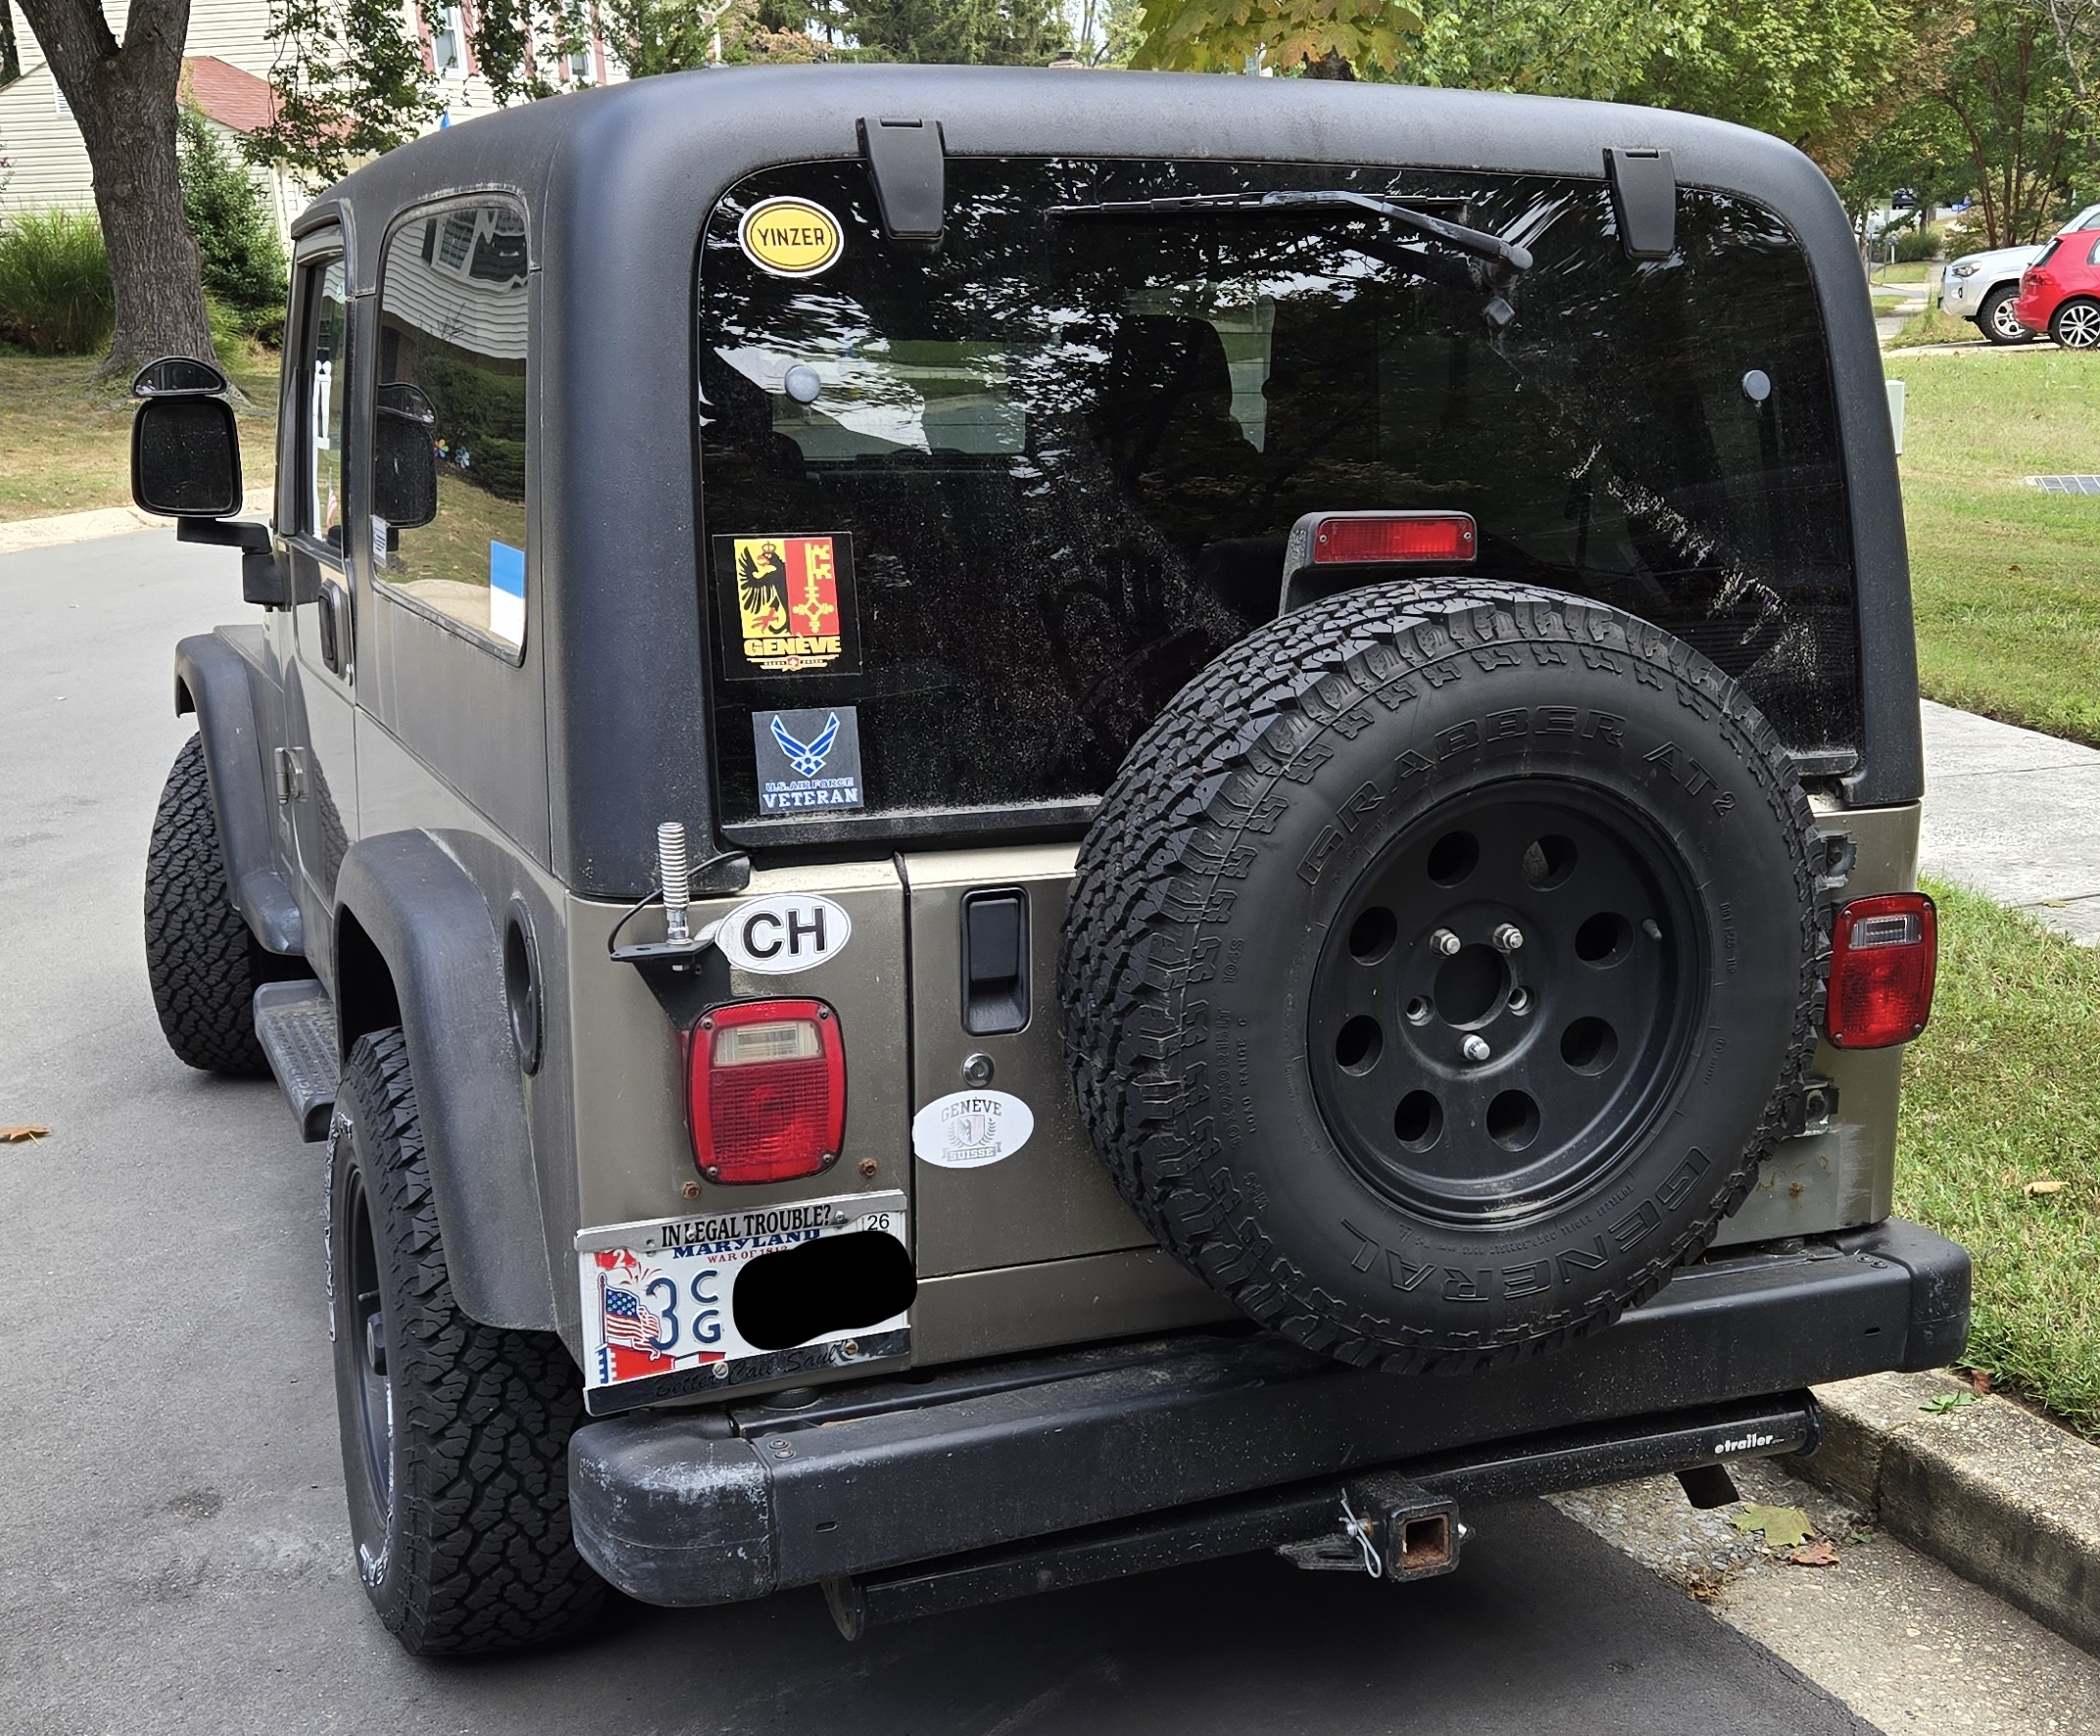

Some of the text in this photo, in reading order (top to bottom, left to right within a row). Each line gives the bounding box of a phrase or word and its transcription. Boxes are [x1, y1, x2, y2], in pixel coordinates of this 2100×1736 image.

[758, 227, 825, 246] YINZER
[743, 633, 842, 657] GENÈVE
[762, 787, 859, 809] VETERAN
[1295, 705, 1629, 886] GRABBER
[742, 906, 827, 960] CH
[1222, 937, 1244, 983] 104S
[941, 1097, 1003, 1123] GENÈVE
[949, 1148, 995, 1161] SUISSE
[661, 1204, 831, 1248] IN LEGAL TROUBLE?
[867, 1213, 890, 1232] 26
[1341, 1146, 1712, 1301] GENERAL
[672, 1229, 821, 1260] MARYLAND
[707, 1252, 738, 1264] WAR
[741, 1249, 757, 1260] OF
[654, 1345, 838, 1398] Better Call Saul
[1714, 1432, 1774, 1454] etrailer
